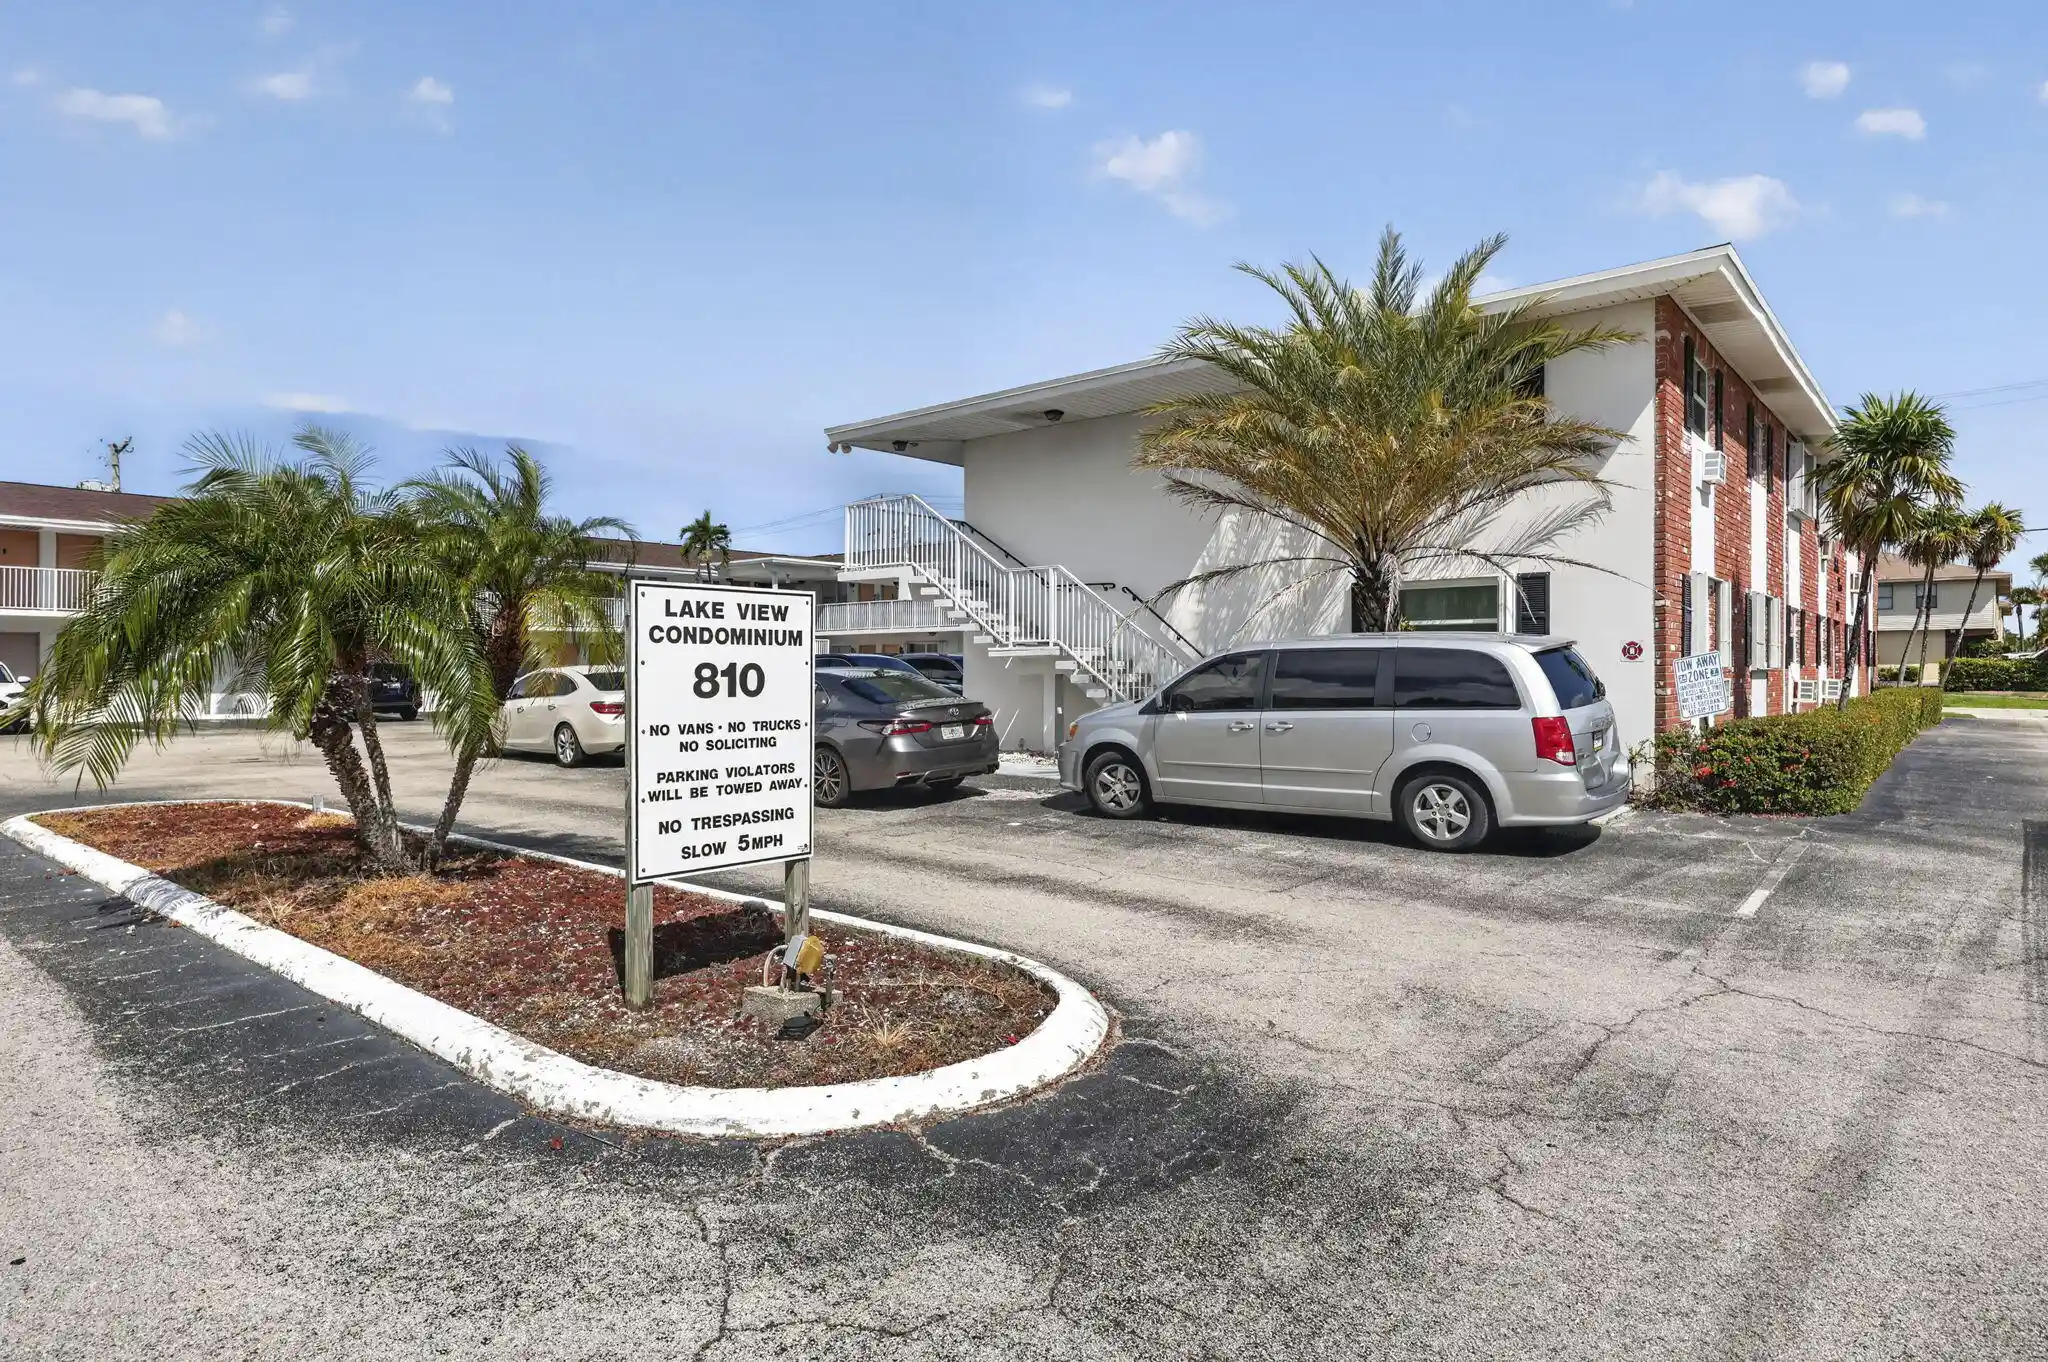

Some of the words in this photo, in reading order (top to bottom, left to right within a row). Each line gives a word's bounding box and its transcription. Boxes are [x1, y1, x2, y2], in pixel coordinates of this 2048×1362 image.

[665, 598, 725, 620] LAKE
[736, 602, 789, 622] VIEW
[648, 624, 803, 647] CONDOMINIUM
[1677, 660, 1692, 672] TOW
[1696, 655, 1717, 668] AWAY
[692, 662, 766, 699] 810
[1688, 668, 1710, 682] ZONE
[649, 724, 670, 737] NO
[677, 722, 714, 735] VANS
[727, 721, 746, 733] NO
[752, 719, 801, 732] TRUCKS
[679, 740, 699, 753] NO
[705, 736, 777, 751] SOLICITING
[656, 768, 719, 784] PARKING
[725, 762, 796, 779] VIOLATORS
[647, 788, 683, 802] WILL
[690, 786, 709, 799] BE
[715, 781, 763, 796] TOWED
[658, 819, 682, 835] NO
[690, 806, 795, 831] TRESPASSING
[681, 841, 727, 860] SLOW
